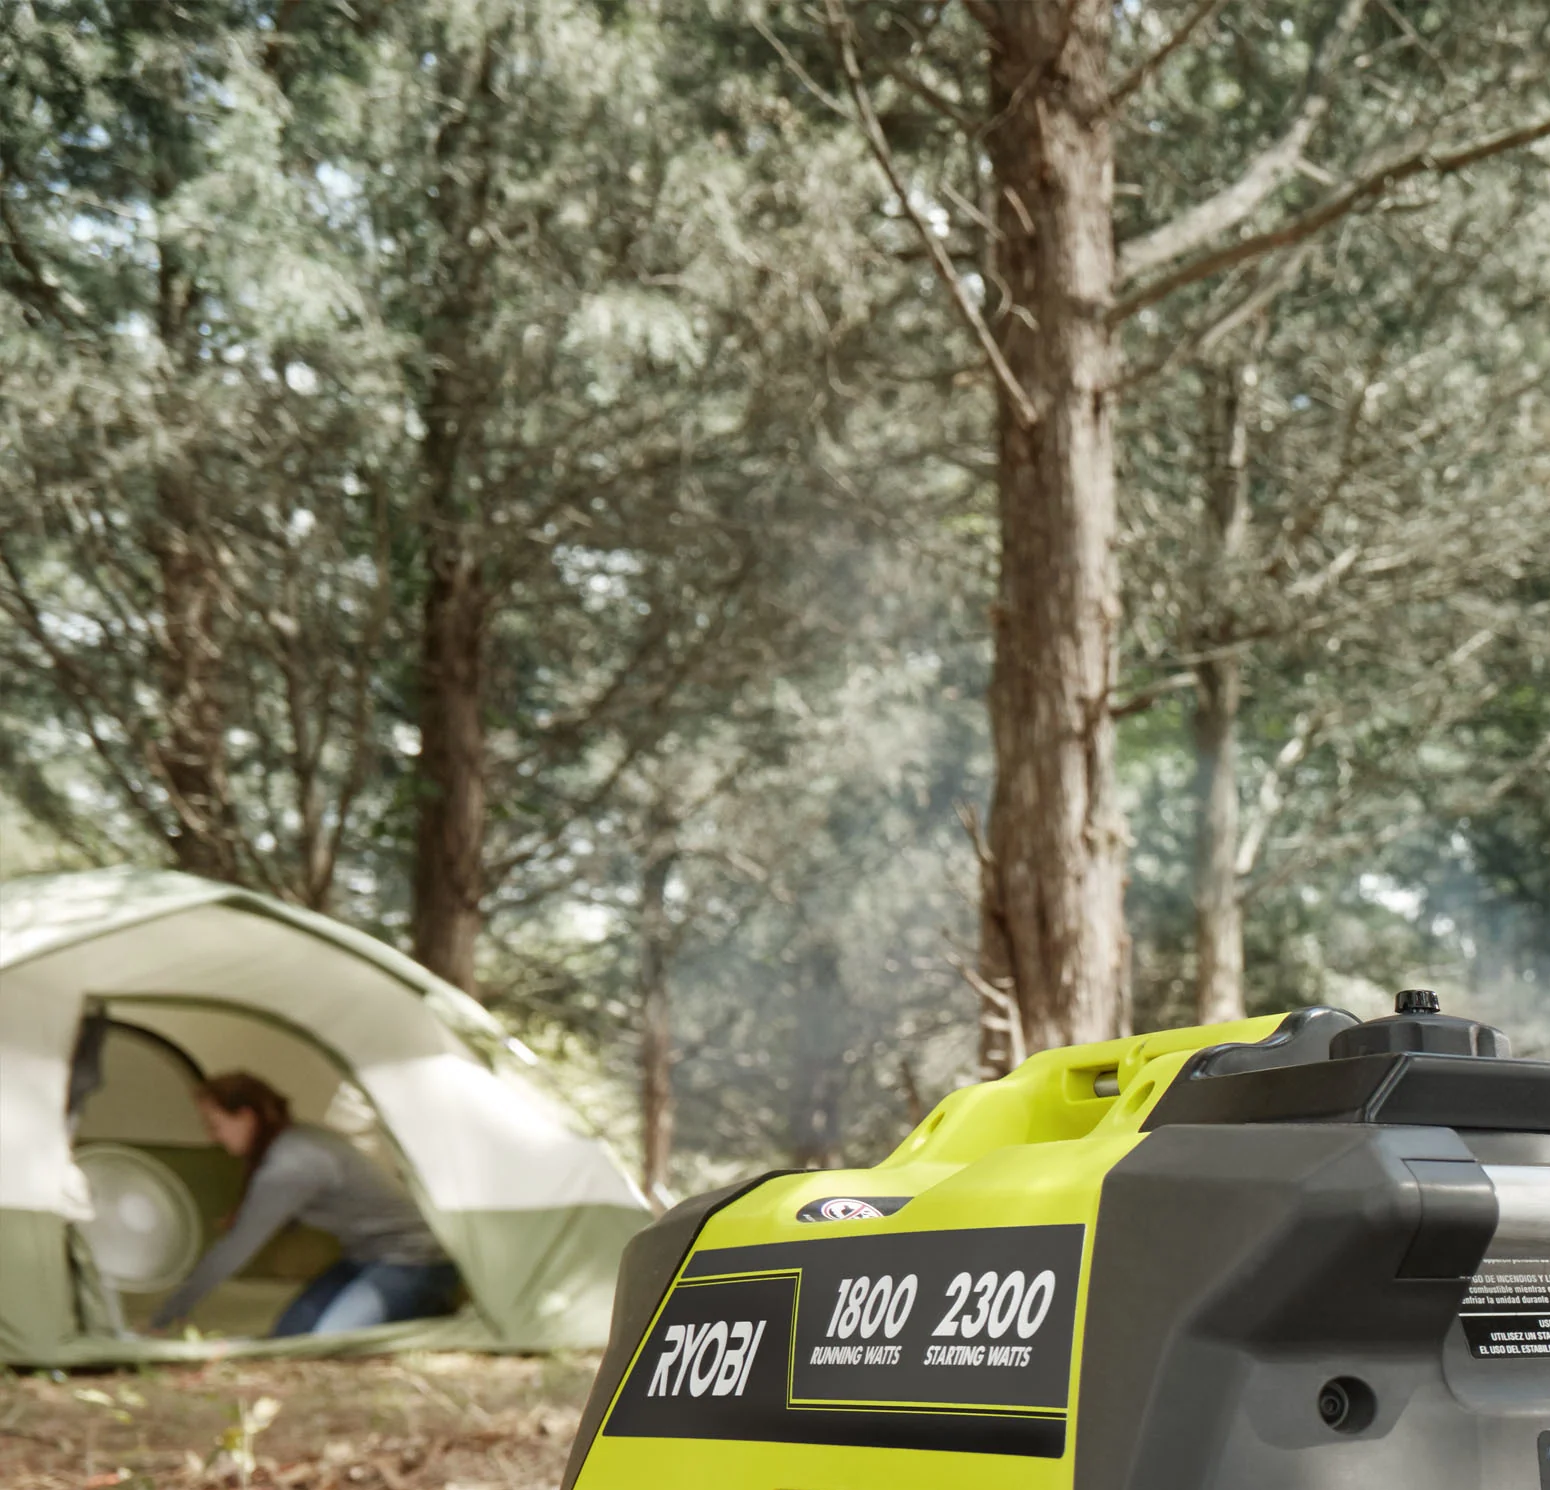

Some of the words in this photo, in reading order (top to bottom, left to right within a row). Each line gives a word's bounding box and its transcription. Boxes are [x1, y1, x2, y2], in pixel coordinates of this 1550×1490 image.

[1469, 1286, 1513, 1294] combustible
[1514, 1285, 1546, 1293] mientras
[825, 1274, 919, 1339] 1800
[931, 1270, 1056, 1339] 2300
[1496, 1296, 1520, 1304] unidad
[1522, 1296, 1548, 1304] durante
[1491, 1332, 1524, 1341] UTILISEZ
[1525, 1332, 1536, 1340] UN
[810, 1346, 863, 1366] RUNNING
[864, 1346, 902, 1366] WATTS
[924, 1346, 985, 1367] STARTING
[986, 1346, 1032, 1367] WATTS
[1479, 1345, 1489, 1354] EL
[1490, 1345, 1506, 1354] USO
[1506, 1345, 1521, 1354] DEL
[647, 1320, 767, 1397] RYOBI
